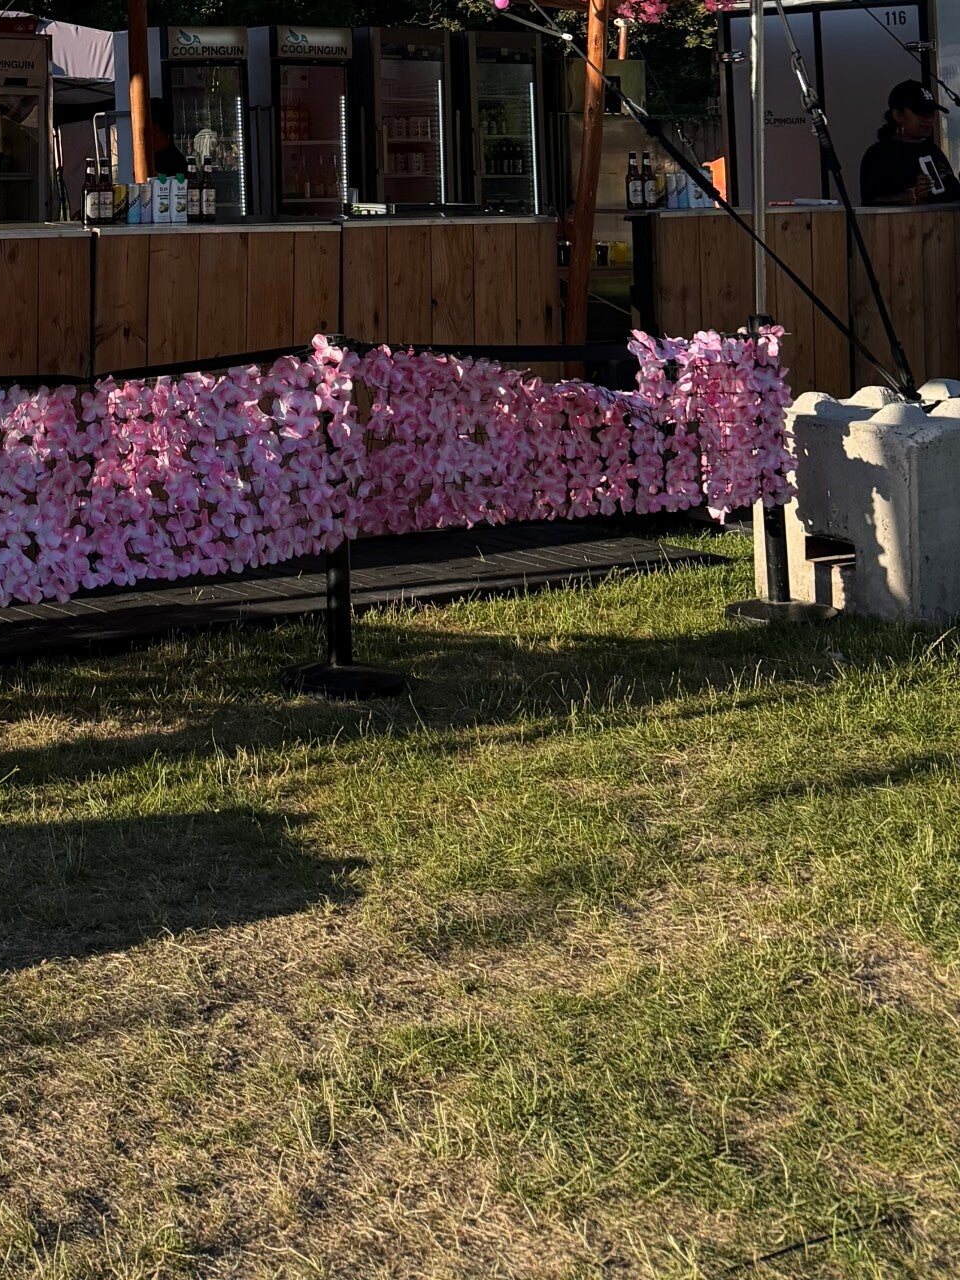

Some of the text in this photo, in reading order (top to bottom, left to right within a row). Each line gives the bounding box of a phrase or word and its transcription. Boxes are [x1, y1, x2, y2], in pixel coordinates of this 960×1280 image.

[885, 11, 906, 26] 116
[172, 46, 244, 56] COOLPINGUIN
[281, 44, 347, 56] COOLPINGUIN
